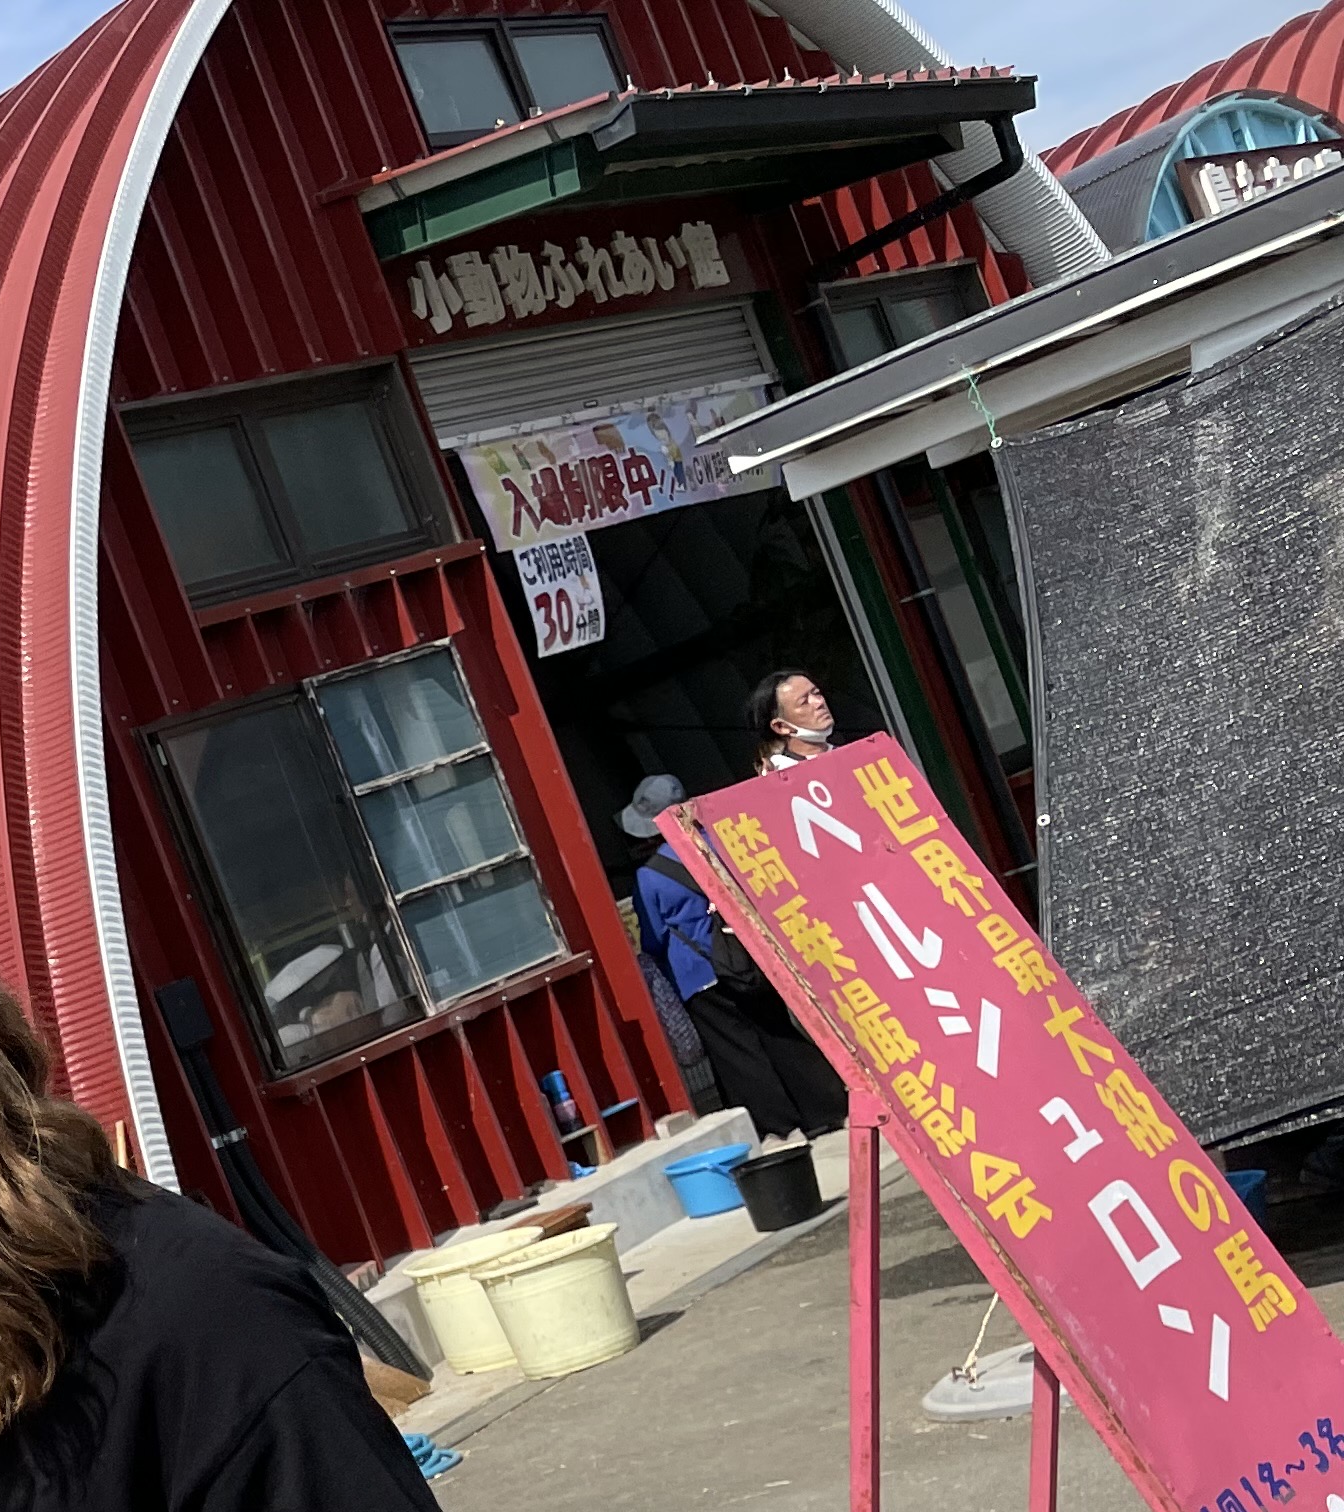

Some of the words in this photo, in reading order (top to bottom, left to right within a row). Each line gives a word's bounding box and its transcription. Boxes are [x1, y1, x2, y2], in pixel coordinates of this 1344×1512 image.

[406, 220, 731, 335] 小動物ふれあい館
[518, 535, 593, 587] ご利用時間
[712, 811, 1053, 1240] 騎乗撮影会
[790, 780, 1231, 1402] ペルシュロン
[851, 756, 1298, 1333] 世界最大級の馬
